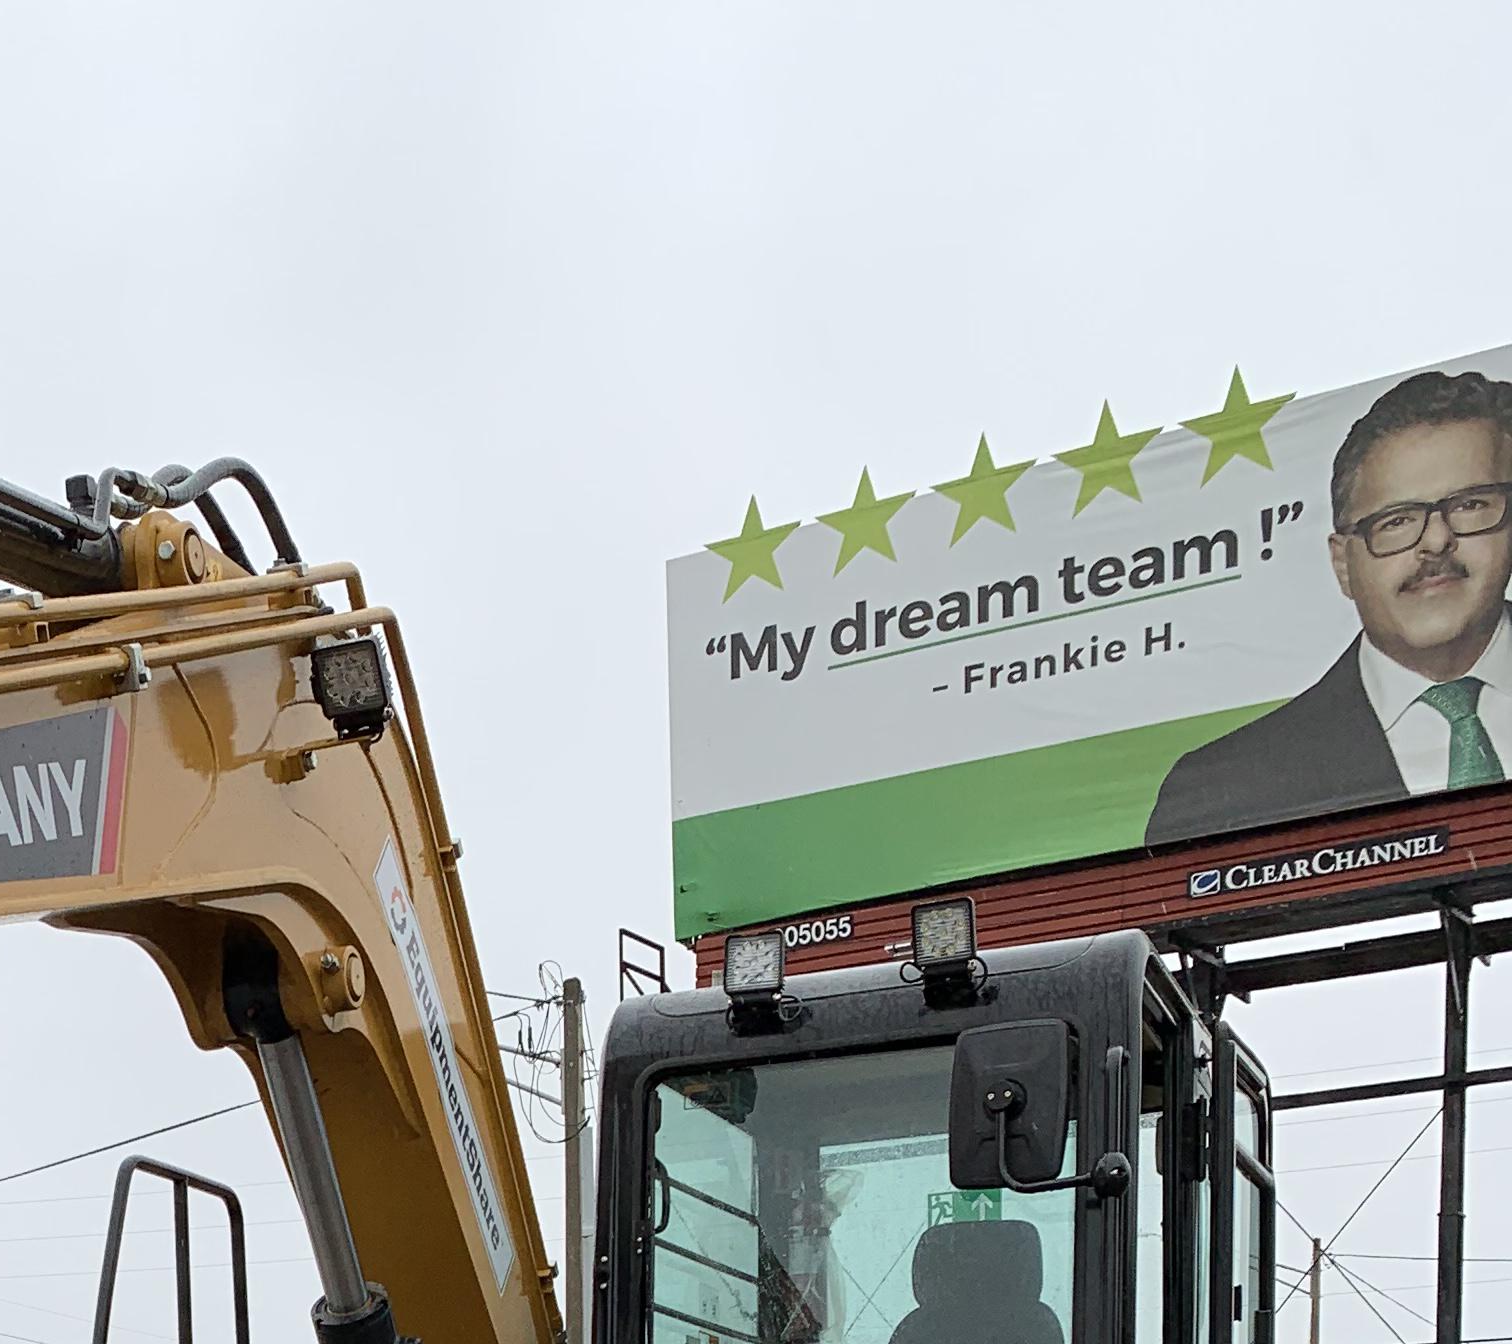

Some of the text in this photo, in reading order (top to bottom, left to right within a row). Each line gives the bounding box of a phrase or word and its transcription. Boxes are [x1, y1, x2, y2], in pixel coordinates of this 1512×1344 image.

[830, 575, 1039, 656] dream
[1058, 529, 1238, 604] team
[964, 635, 1127, 694] Frankie
[1144, 622, 1186, 656] H.
[778, 916, 851, 948] 05055
[394, 930, 503, 1252] EquipmentShare
